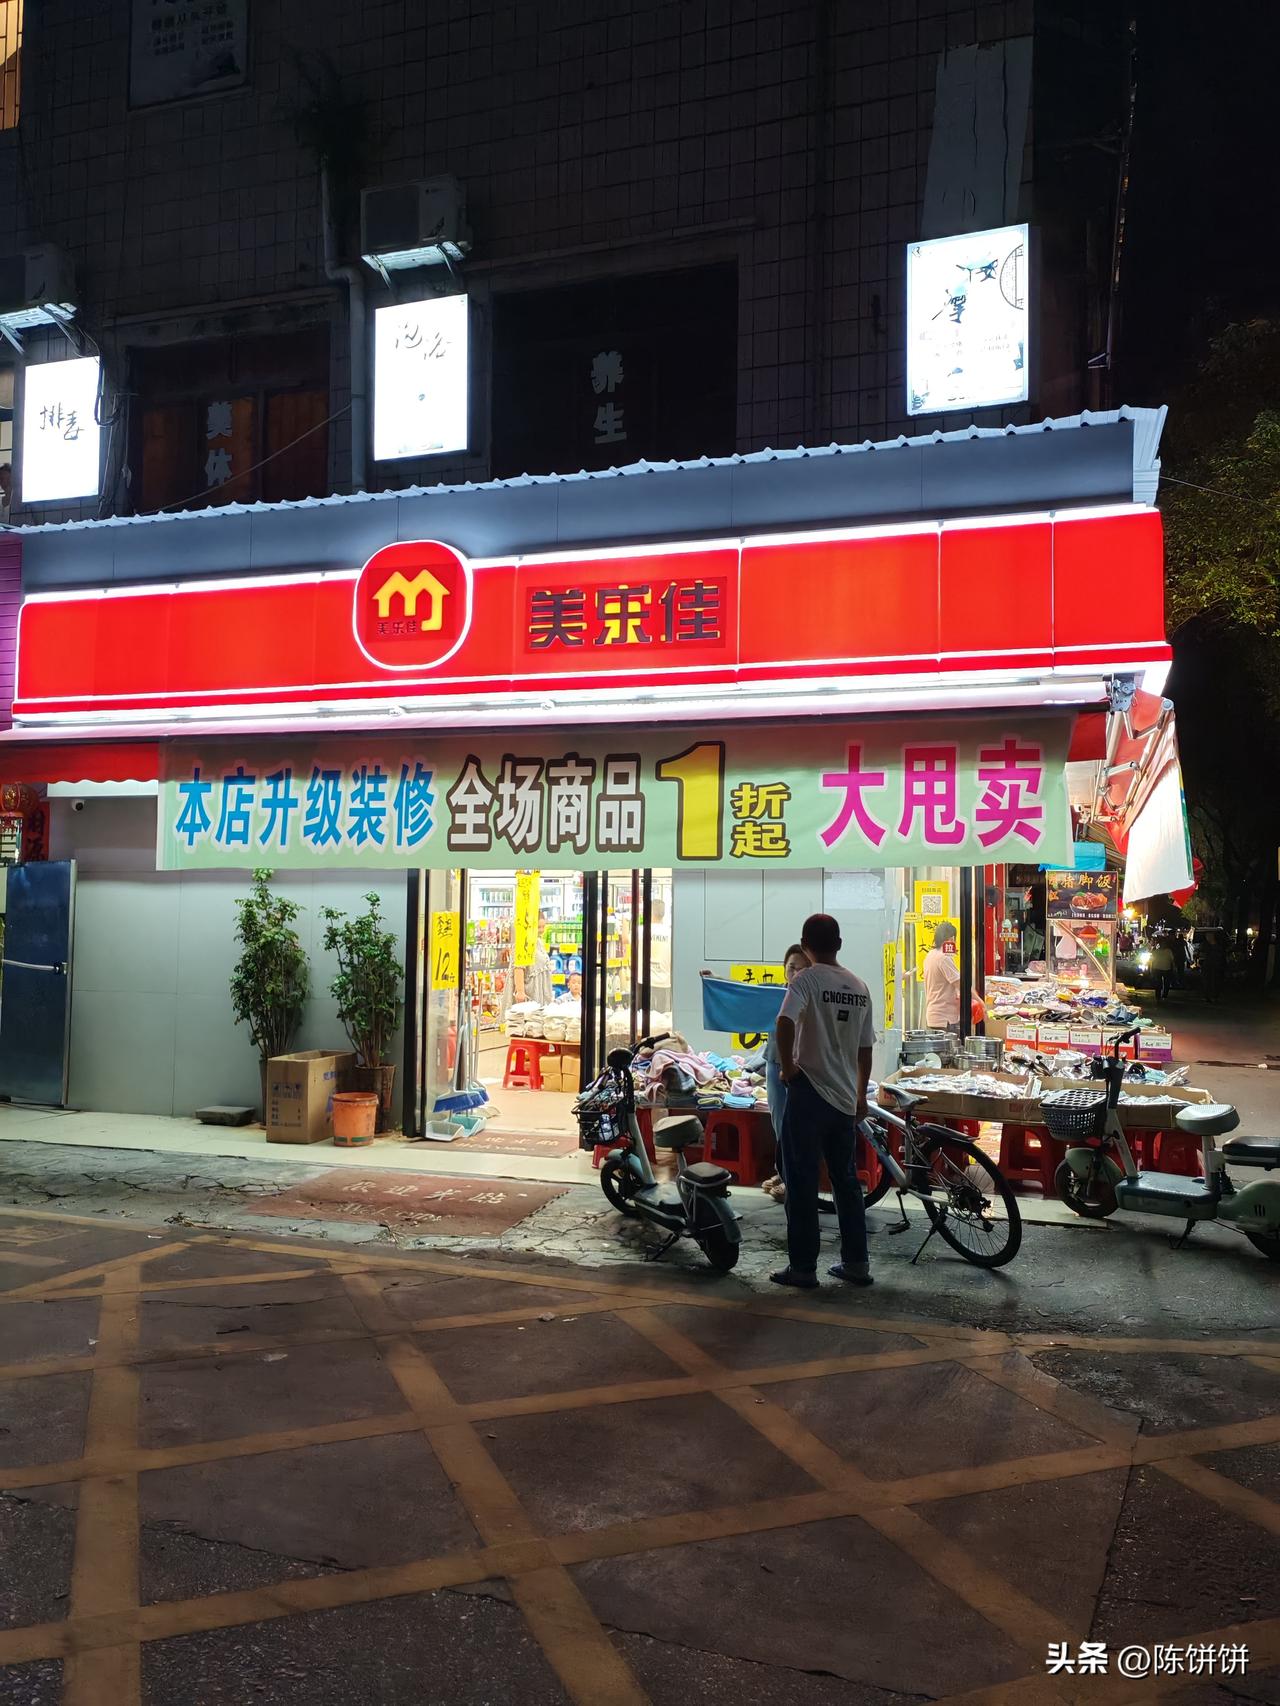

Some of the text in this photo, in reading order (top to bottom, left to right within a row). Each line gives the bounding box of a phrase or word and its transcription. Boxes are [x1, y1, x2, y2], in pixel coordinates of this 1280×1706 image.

[529, 579, 721, 648] 美乐佳
[175, 761, 436, 847] 本店升级装修
[448, 757, 643, 850] 全场商品
[820, 739, 1044, 848] 大甩卖
